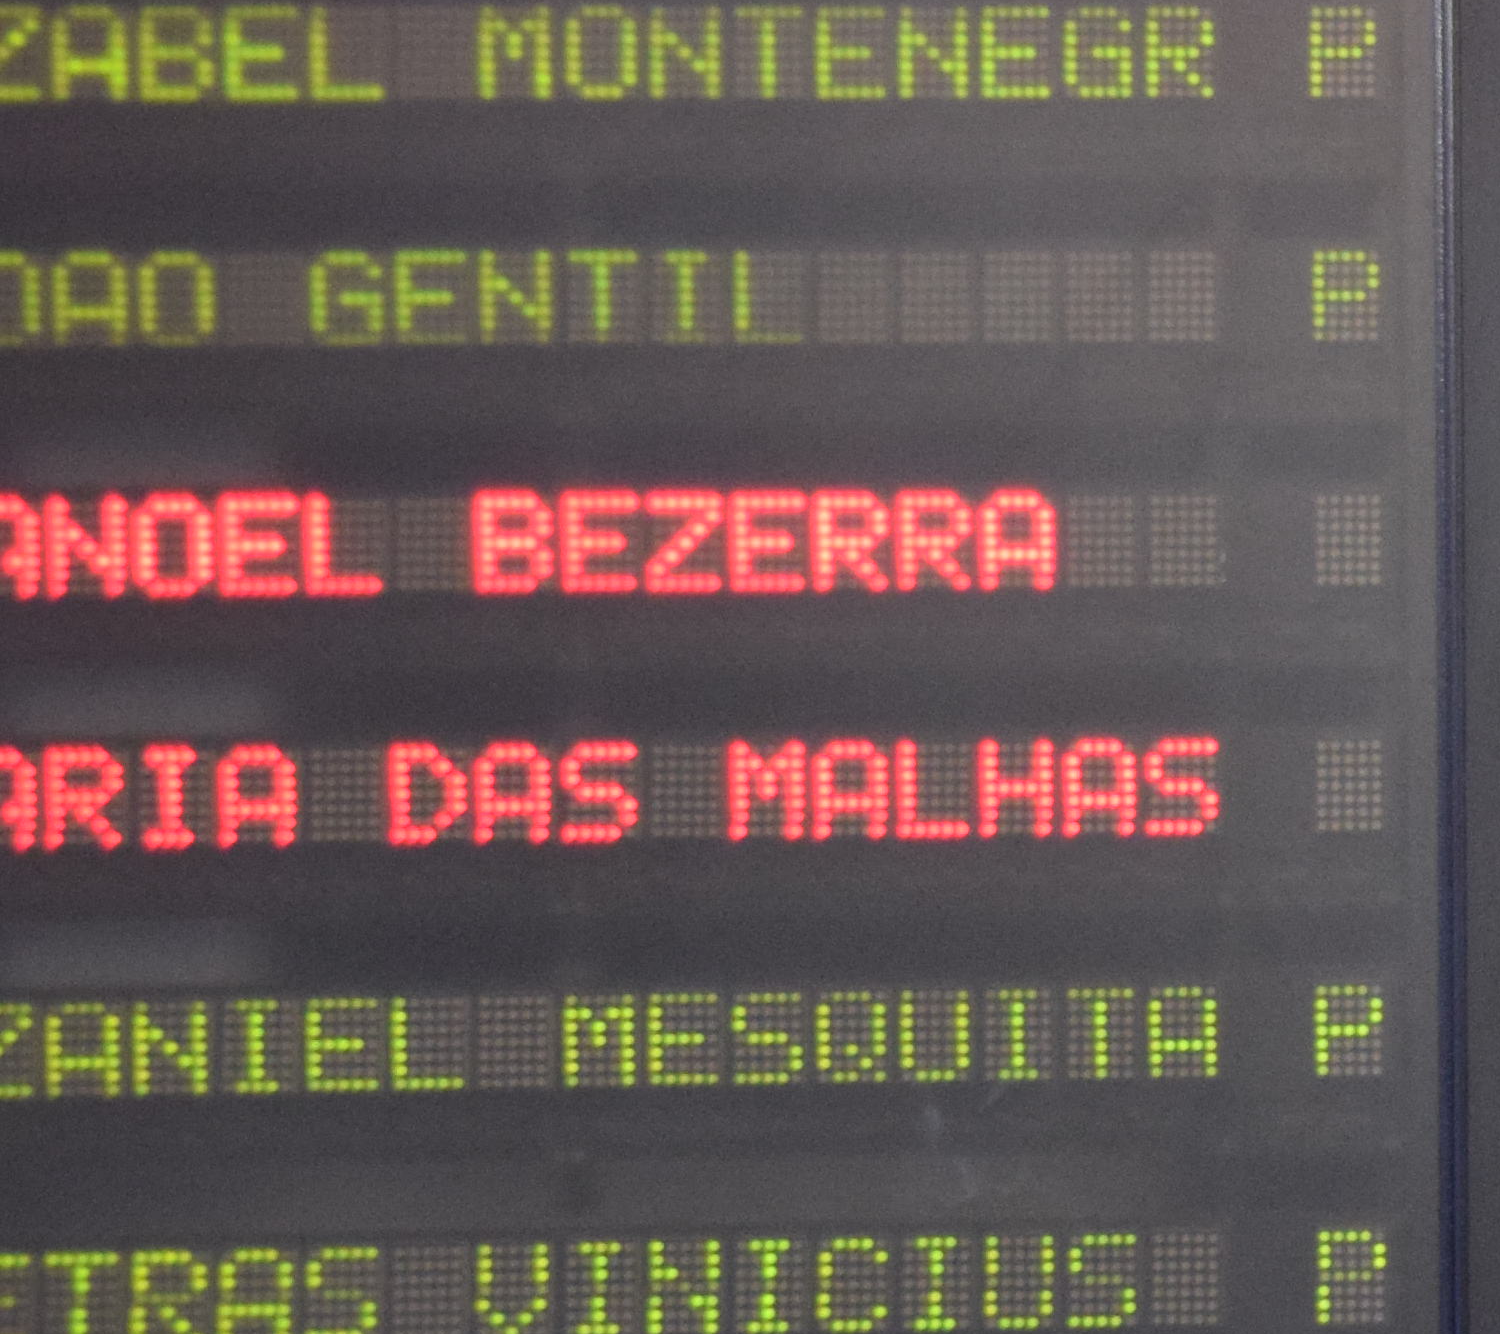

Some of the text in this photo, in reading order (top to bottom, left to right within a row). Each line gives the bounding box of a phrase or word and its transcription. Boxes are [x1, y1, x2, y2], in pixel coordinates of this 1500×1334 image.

[476, 7, 1215, 100] MONTENEGR
[1308, 9, 1377, 98] P
[308, 249, 806, 342] GENTIL
[1311, 250, 1380, 343] P
[467, 486, 1059, 596] BEZERRA
[384, 739, 640, 847] DAS
[723, 735, 1221, 842] MALHAS
[562, 988, 1218, 1087] MESQUITA
[1313, 986, 1384, 1075] P
[1315, 1230, 1388, 1324] P
